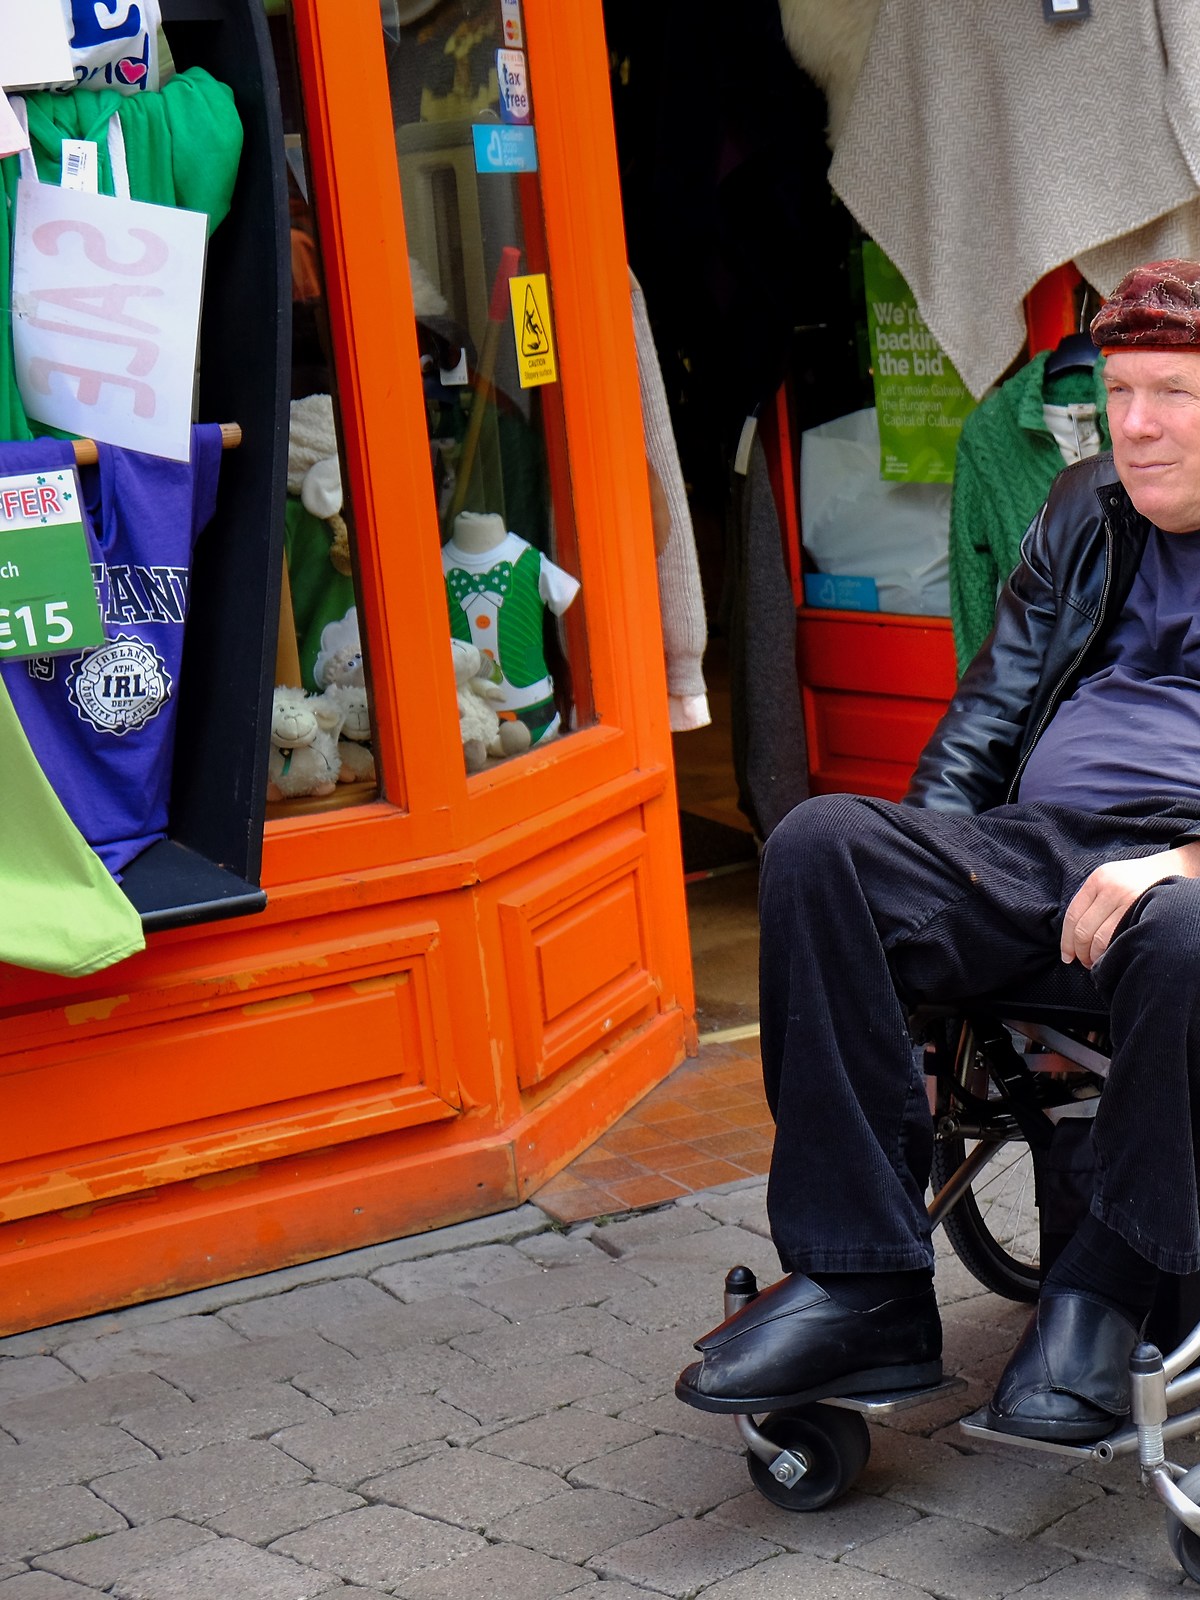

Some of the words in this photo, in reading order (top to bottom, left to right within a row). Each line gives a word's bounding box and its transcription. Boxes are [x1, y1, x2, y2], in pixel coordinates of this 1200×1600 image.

[503, 63, 521, 86] tax
[505, 90, 527, 109] free
[876, 326, 942, 353] backin
[528, 359, 546, 368] CAUTION
[878, 352, 909, 375] the
[913, 352, 944, 375] bid
[881, 384, 903, 396] Let's
[904, 384, 929, 396] make
[931, 384, 965, 400] Galway
[882, 400, 898, 411] the
[899, 399, 943, 413] European
[883, 414, 916, 428] Capital
[917, 414, 926, 426] of
[928, 414, 963, 427] Culture
[0, 561, 20, 578] ch
[95, 647, 147, 667] IRELAND
[102, 674, 146, 698] IRL
[82, 685, 111, 720] QUALITY
[111, 699, 134, 707] DEPT
